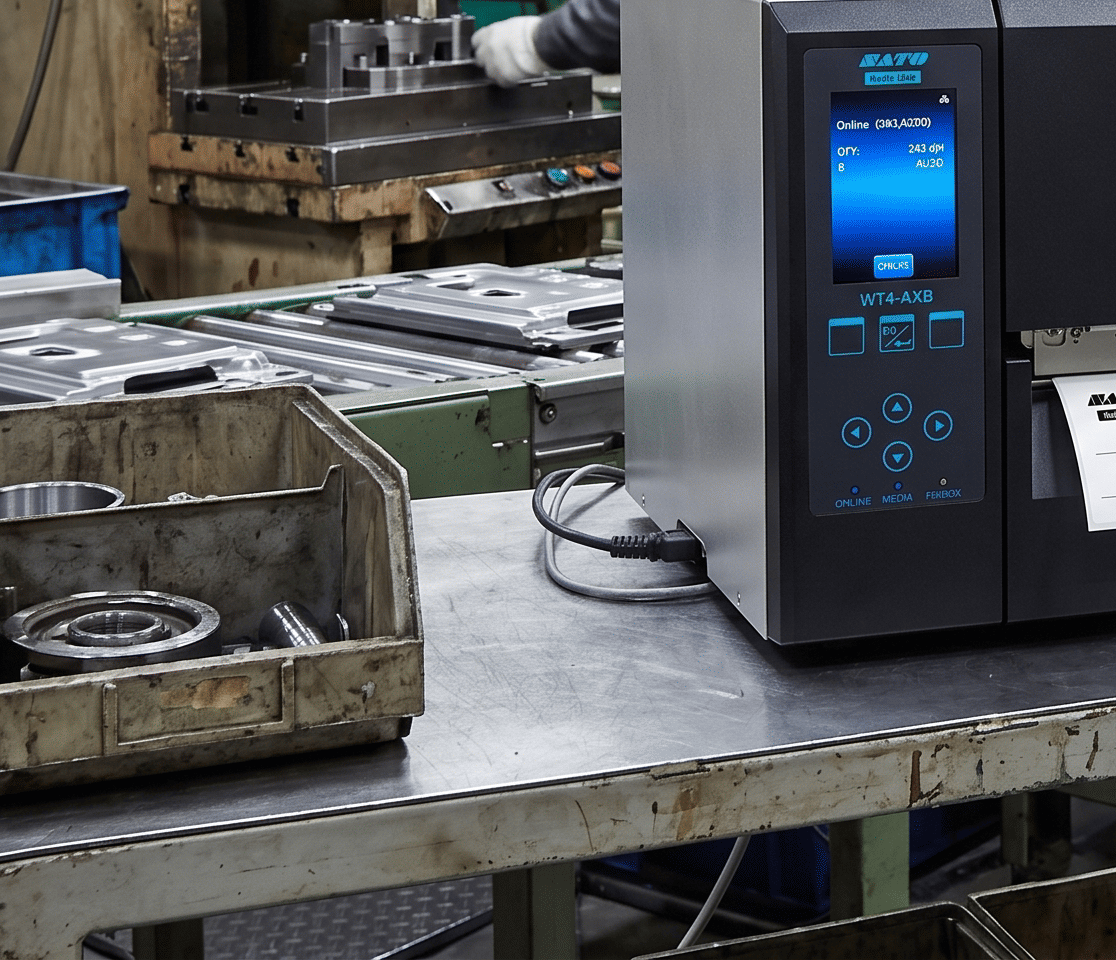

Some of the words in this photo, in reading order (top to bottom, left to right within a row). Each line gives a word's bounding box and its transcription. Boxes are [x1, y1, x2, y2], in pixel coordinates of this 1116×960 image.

[836, 119, 870, 131] Online
[860, 289, 933, 307] WT4-AXB
[881, 493, 913, 504] MEDIA
